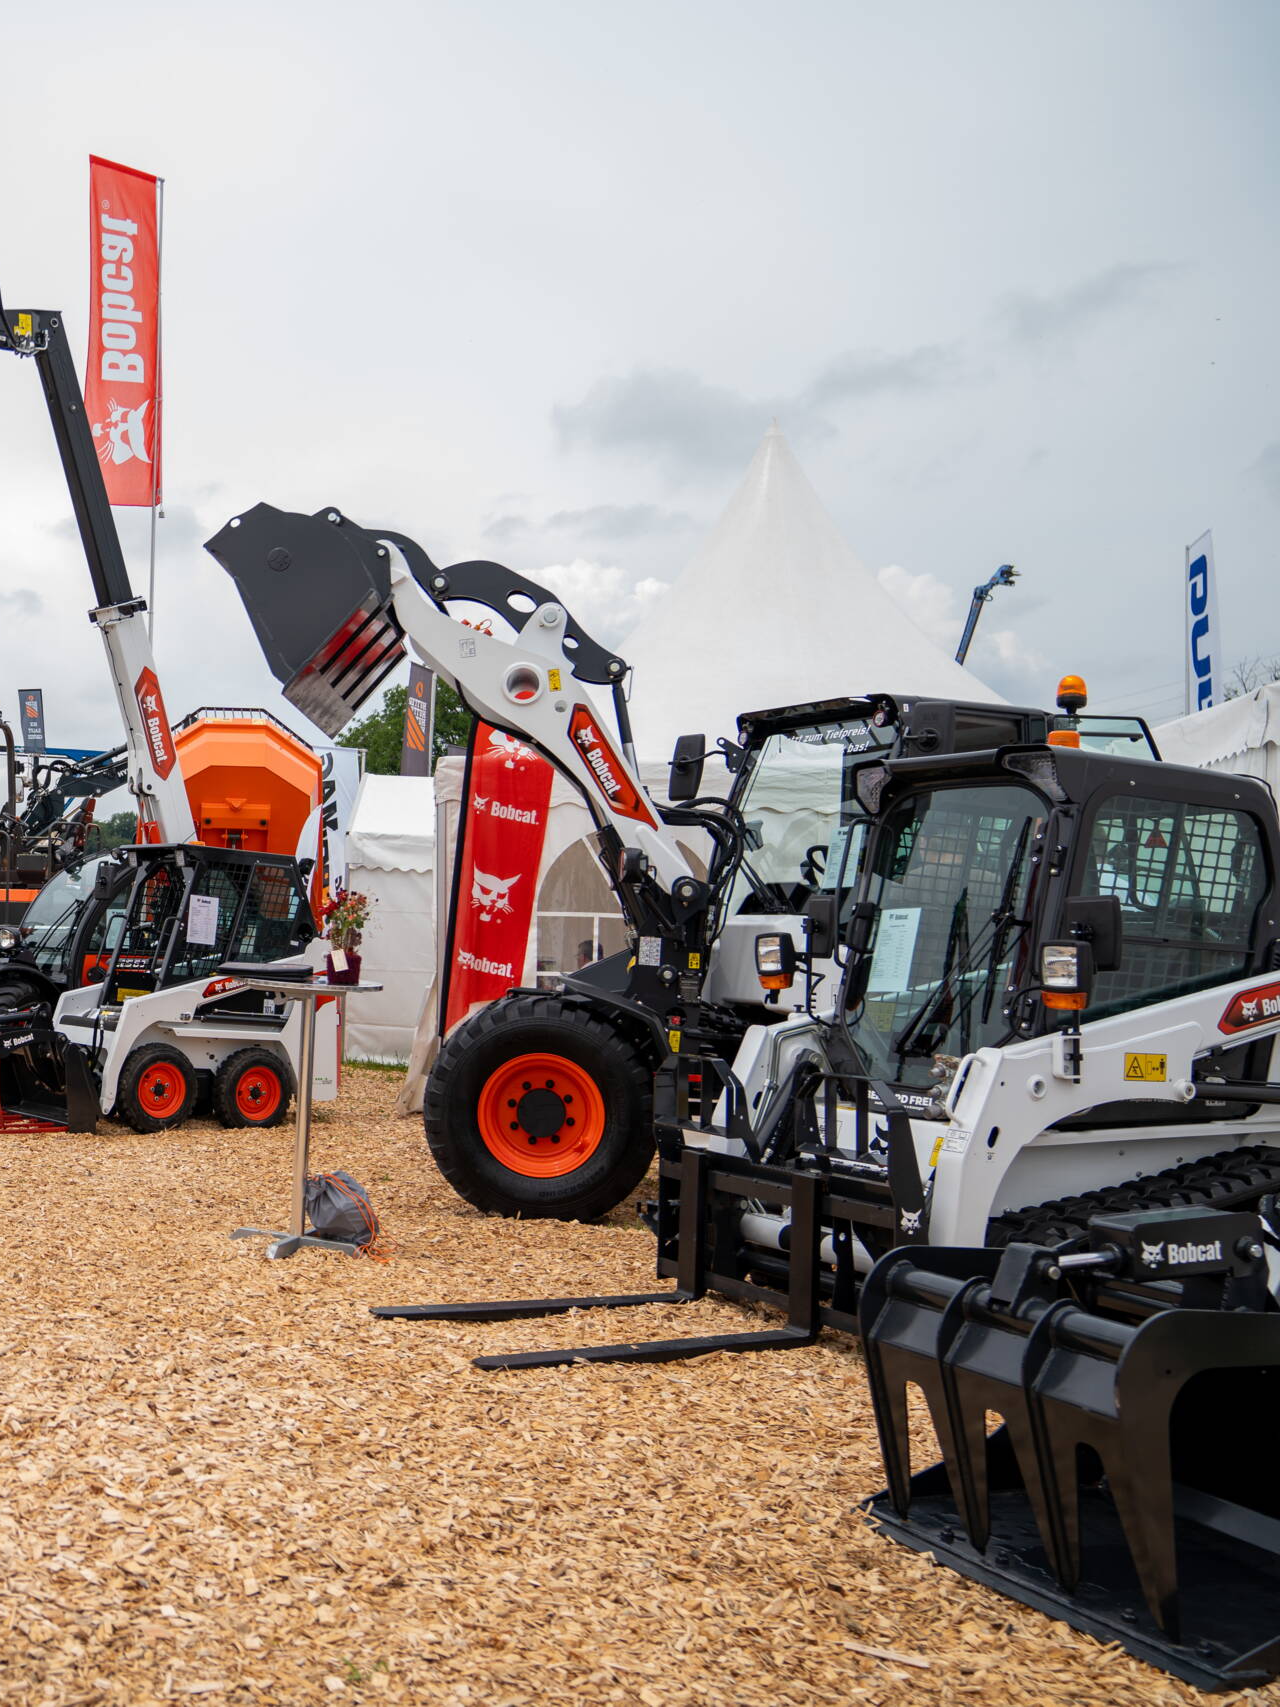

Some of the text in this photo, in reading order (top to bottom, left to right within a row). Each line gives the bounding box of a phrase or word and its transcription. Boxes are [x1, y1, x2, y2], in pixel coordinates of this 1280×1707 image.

[148, 717, 168, 763] Bobcat
[804, 733, 823, 744] zum
[825, 725, 872, 741] Tiefpreis!
[848, 741, 870, 753] bas!
[587, 748, 622, 797] Bobcat
[491, 801, 540, 826] Bobcat
[12, 1033, 34, 1046] Bobcat
[909, 1095, 933, 1107] FREI
[1167, 1240, 1222, 1265] Bobcat
